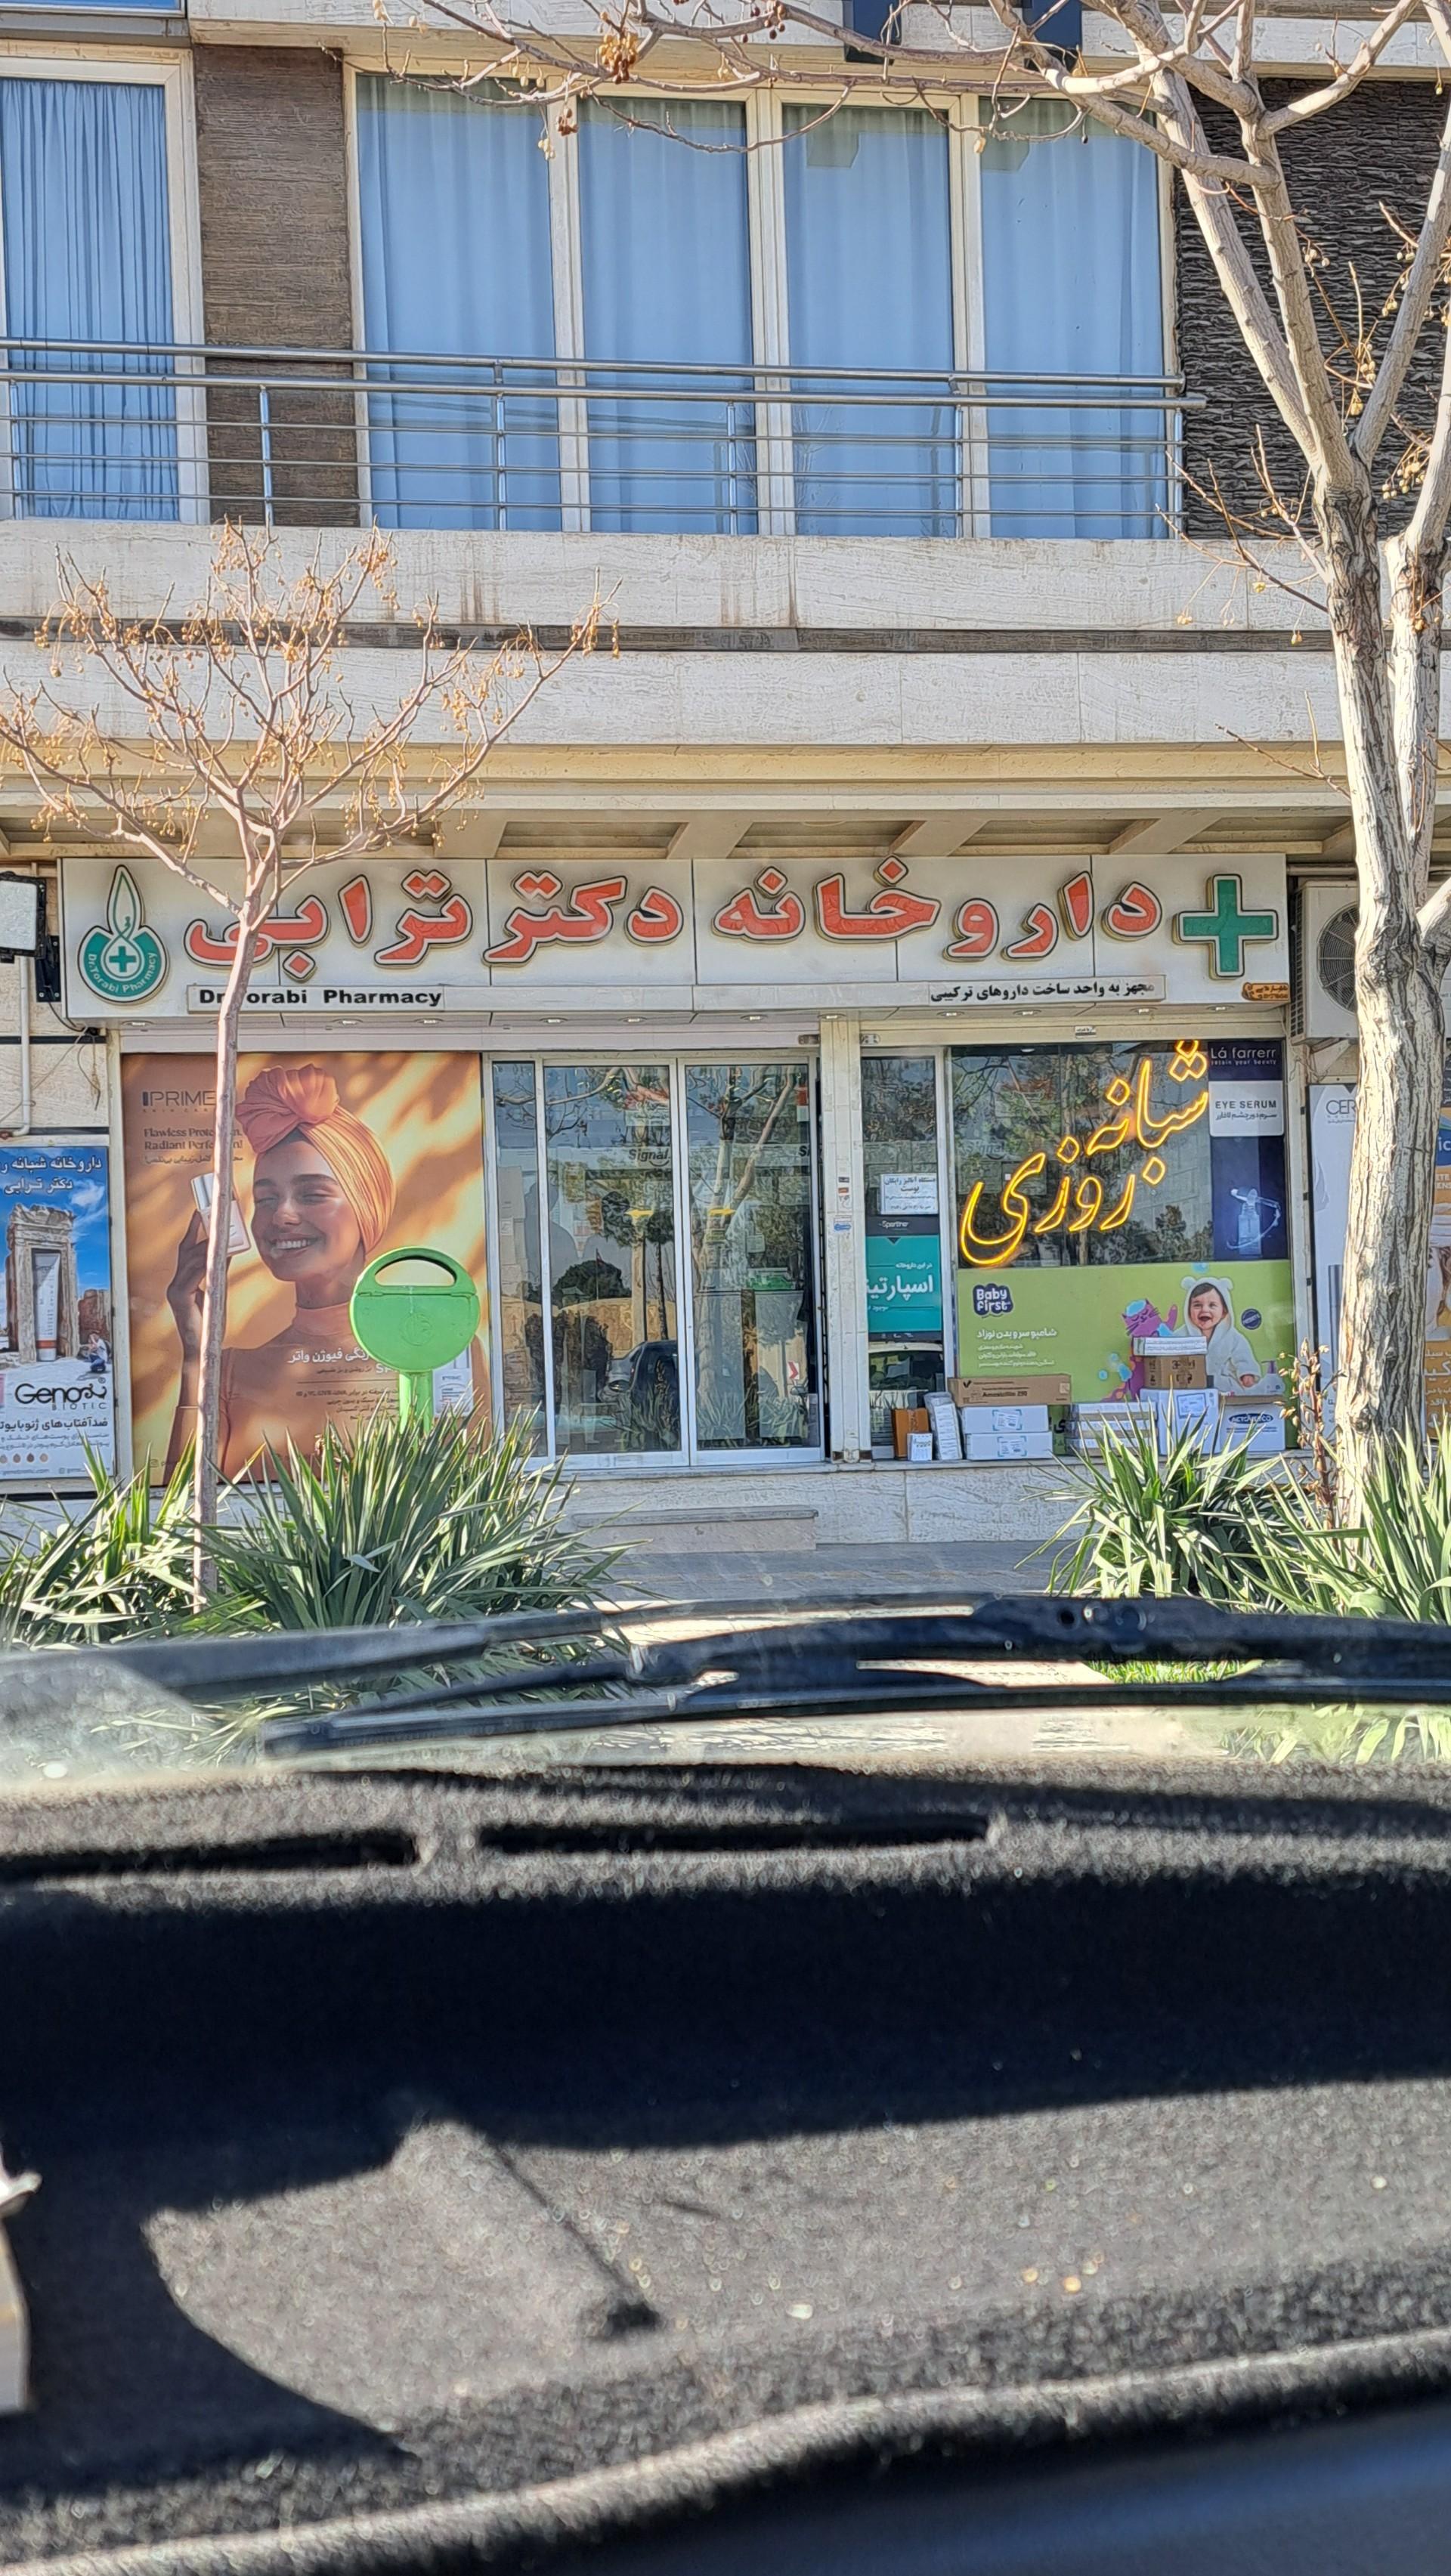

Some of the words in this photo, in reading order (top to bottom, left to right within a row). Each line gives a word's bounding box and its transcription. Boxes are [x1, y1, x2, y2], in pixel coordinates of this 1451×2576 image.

[711, 855, 1164, 963] داروخانه
[184, 869, 474, 982] ترابی
[482, 869, 685, 968] دکتر
[122, 952, 158, 993] Pharmacy
[976, 984, 1029, 1000] داروهای
[1033, 983, 1070, 995] ساخت
[1073, 982, 1105, 997] واحد
[1108, 983, 1120, 994] به
[323, 990, 442, 1007] Pharmacy
[1215, 1100, 1236, 1109] EYE
[1239, 1100, 1276, 1109] SERUM
[11, 1156, 47, 1173] شبانه
[50, 1156, 102, 1173] داروخانه
[5, 1177, 43, 1195] ترابی
[47, 1177, 73, 1193] دکتر
[976, 1288, 1007, 1300] Baby
[52, 1402, 107, 1411] BIOTIC
